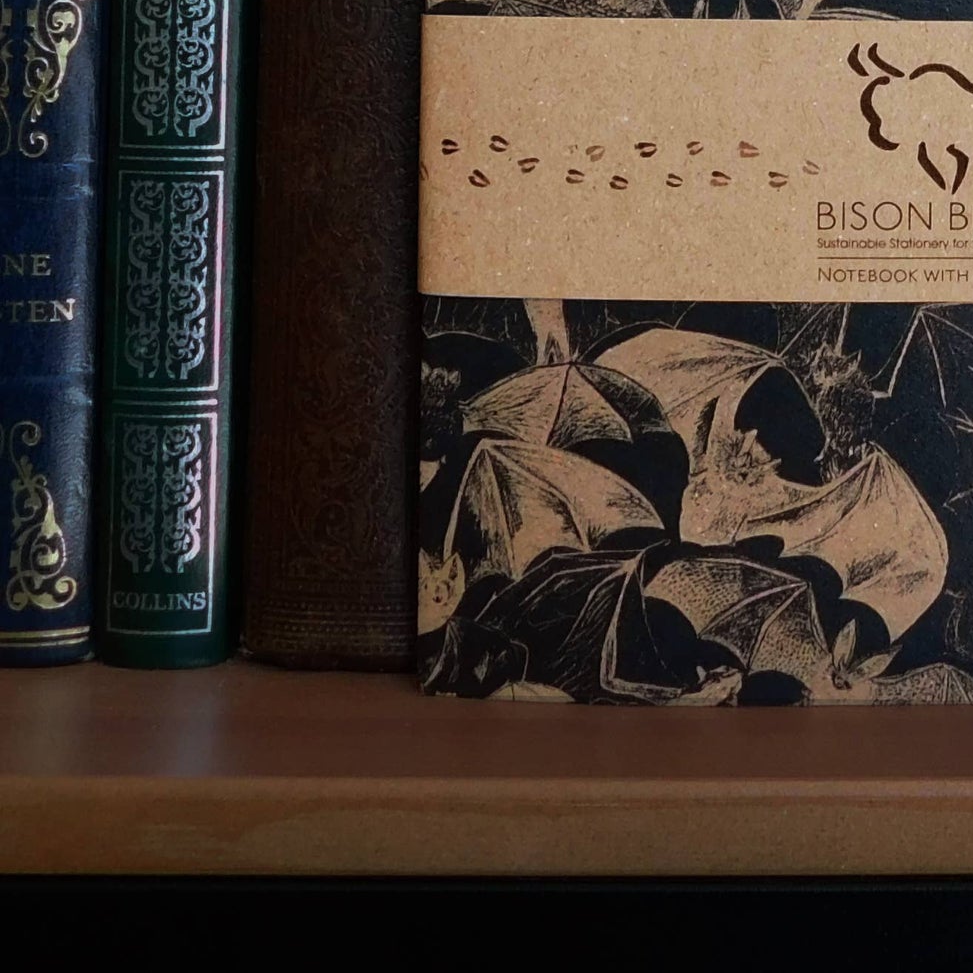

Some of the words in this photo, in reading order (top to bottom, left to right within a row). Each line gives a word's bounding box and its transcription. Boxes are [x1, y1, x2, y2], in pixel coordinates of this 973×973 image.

[817, 201, 932, 231] BISON
[817, 237, 886, 250] Sustainable
[889, 237, 950, 250] Stationery
[953, 237, 969, 249] for
[817, 267, 918, 283] NOTEBOOK
[923, 269, 969, 283] WITH
[0, 297, 77, 323] TEN
[113, 590, 207, 611] COLLINS
